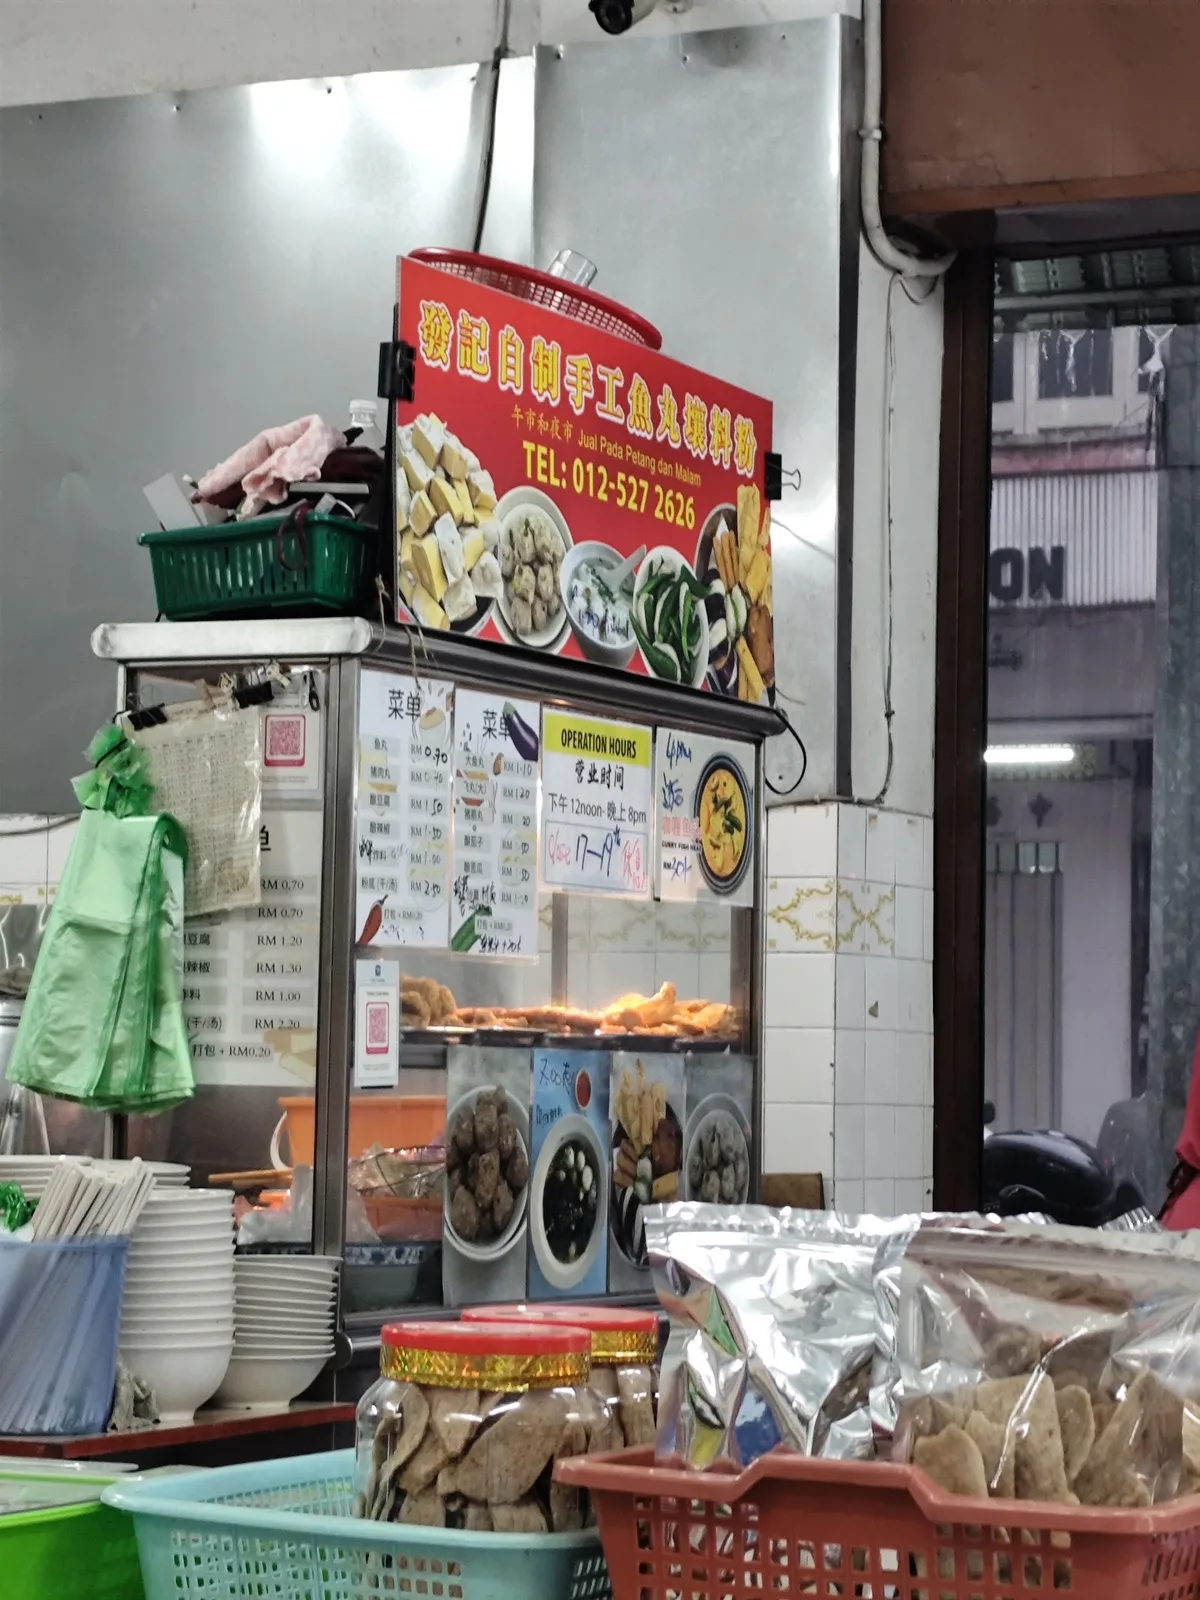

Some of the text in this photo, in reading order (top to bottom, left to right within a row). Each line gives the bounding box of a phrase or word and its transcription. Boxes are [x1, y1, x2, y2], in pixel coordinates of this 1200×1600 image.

[511, 404, 574, 443] 午市和夜市
[578, 430, 701, 487] Jual Pada Petang dan Malam
[522, 440, 696, 530] TEL: 012-527 2626
[989, 546, 1064, 602] ON
[388, 689, 421, 721] 菜单
[410, 743, 422, 755] RM
[561, 728, 637, 759] OPERATION HOURS
[503, 761, 514, 772] RM
[410, 771, 422, 783] RM
[575, 759, 625, 791] 营业时间
[503, 788, 514, 798] RM
[410, 798, 422, 809] RM
[548, 792, 568, 814] 下午
[607, 800, 626, 822] 晚上
[628, 806, 647, 826] 8pm
[502, 814, 513, 825] RM
[410, 825, 422, 837] RM
[502, 840, 513, 851] RM
[410, 853, 422, 865] RM
[501, 866, 513, 877] RM
[281, 879, 304, 891] 0.70
[410, 881, 422, 892] RM
[258, 907, 303, 920] RM 0.70
[184, 932, 303, 947] 豆腐 RM 1.20
[184, 961, 302, 974] 辣椒 RM 1.30
[255, 991, 275, 1001] RM
[279, 991, 301, 1002] 1.00
[255, 1018, 274, 1030] RM
[278, 1019, 300, 1030] 2.20
[192, 1043, 216, 1057] 打包
[229, 1046, 271, 1058] RM0.20
